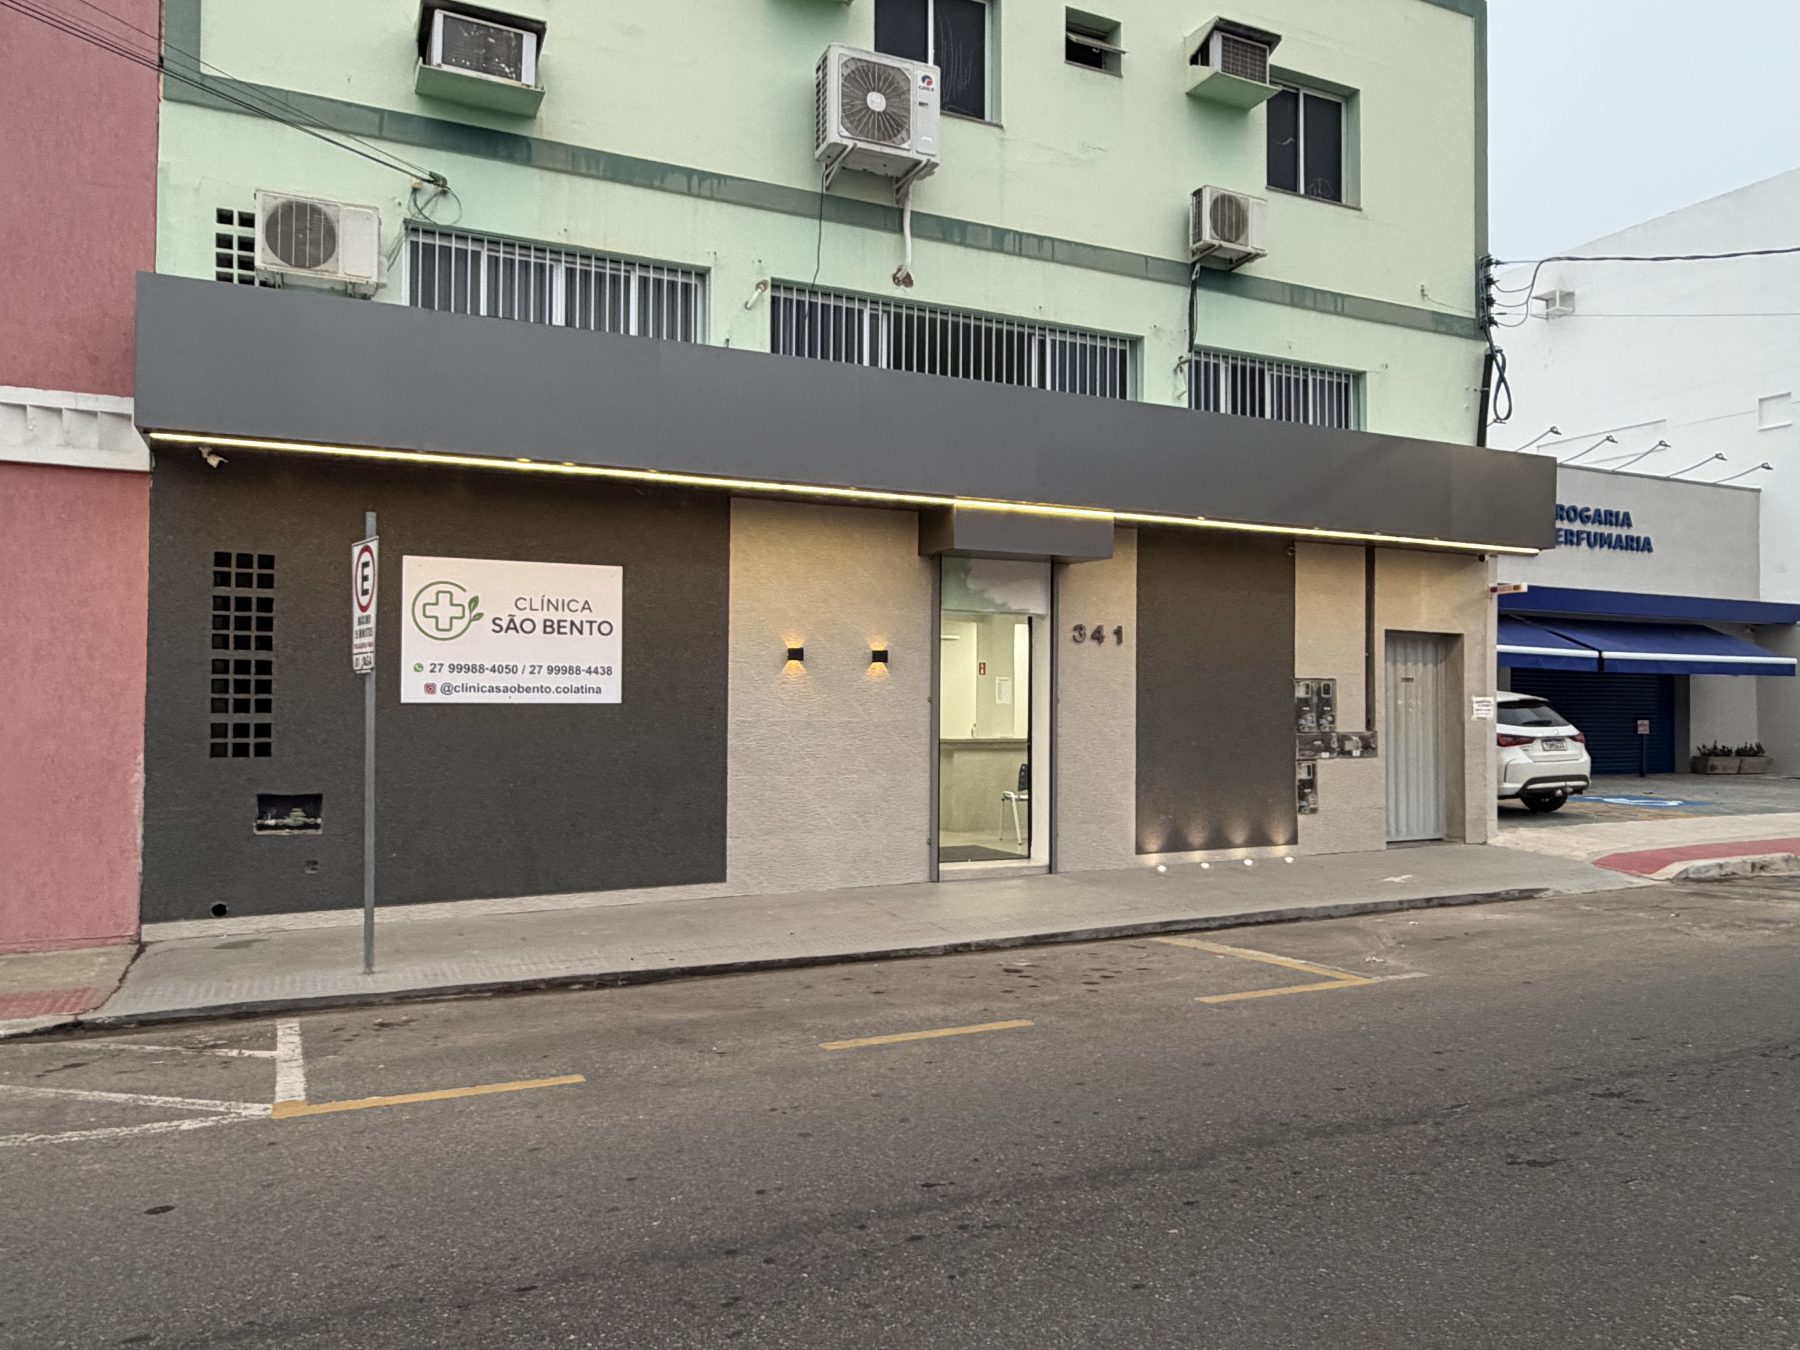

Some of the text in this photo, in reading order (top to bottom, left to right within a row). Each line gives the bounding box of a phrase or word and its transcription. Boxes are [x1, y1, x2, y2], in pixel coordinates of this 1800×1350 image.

[361, 561, 370, 597] E
[514, 594, 593, 613] CLÍNICA
[491, 614, 614, 636] SÃO BENTO
[1072, 624, 1123, 646] 341
[429, 663, 444, 673] 27
[448, 663, 518, 674] 99988-4050
[529, 664, 543, 675] 27
[547, 665, 613, 676] 99988-4438
[440, 682, 602, 695] @clinicasaobento.colatina
